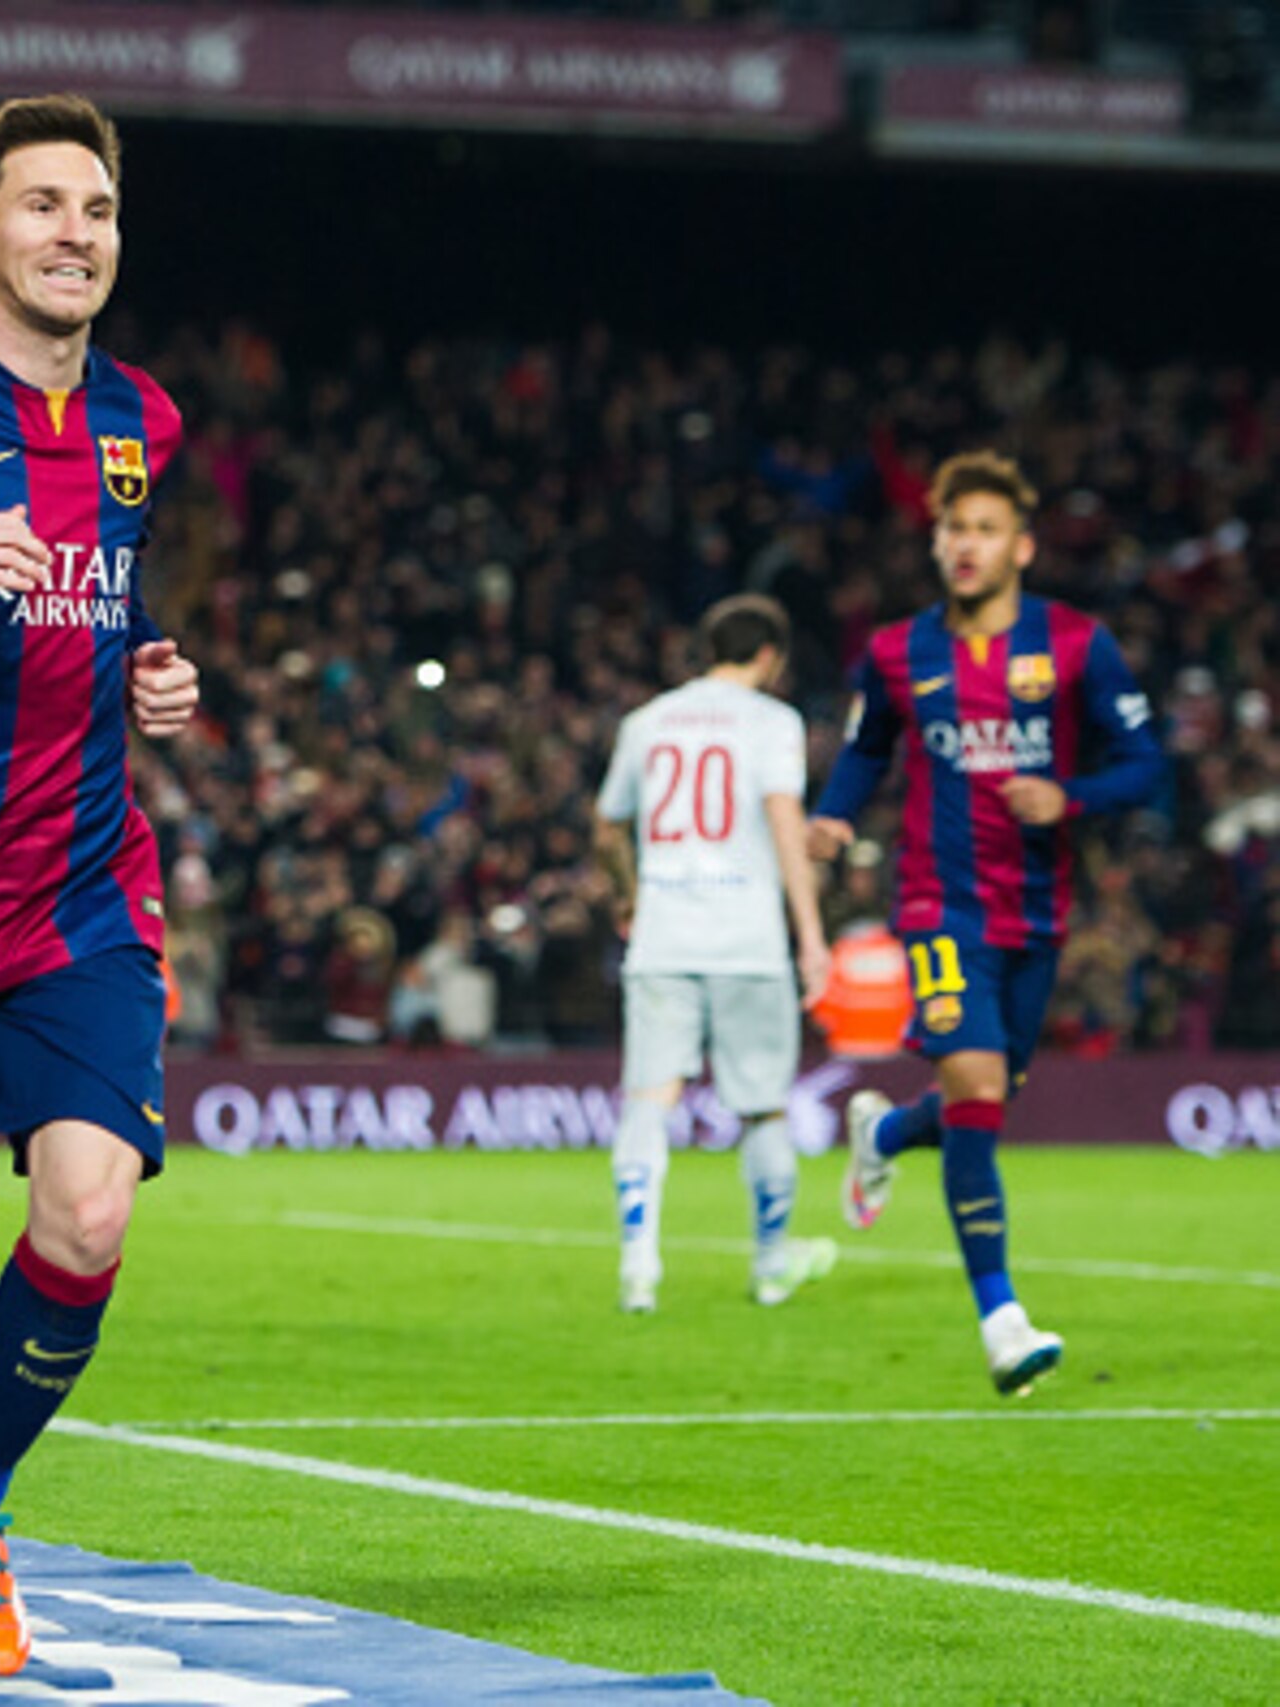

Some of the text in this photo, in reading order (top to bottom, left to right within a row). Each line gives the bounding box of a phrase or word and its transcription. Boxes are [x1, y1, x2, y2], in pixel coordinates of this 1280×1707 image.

[646, 744, 734, 842] 20
[909, 936, 967, 999] 11
[193, 1083, 434, 1157] QATAR
[1166, 1083, 1280, 1157] QA
